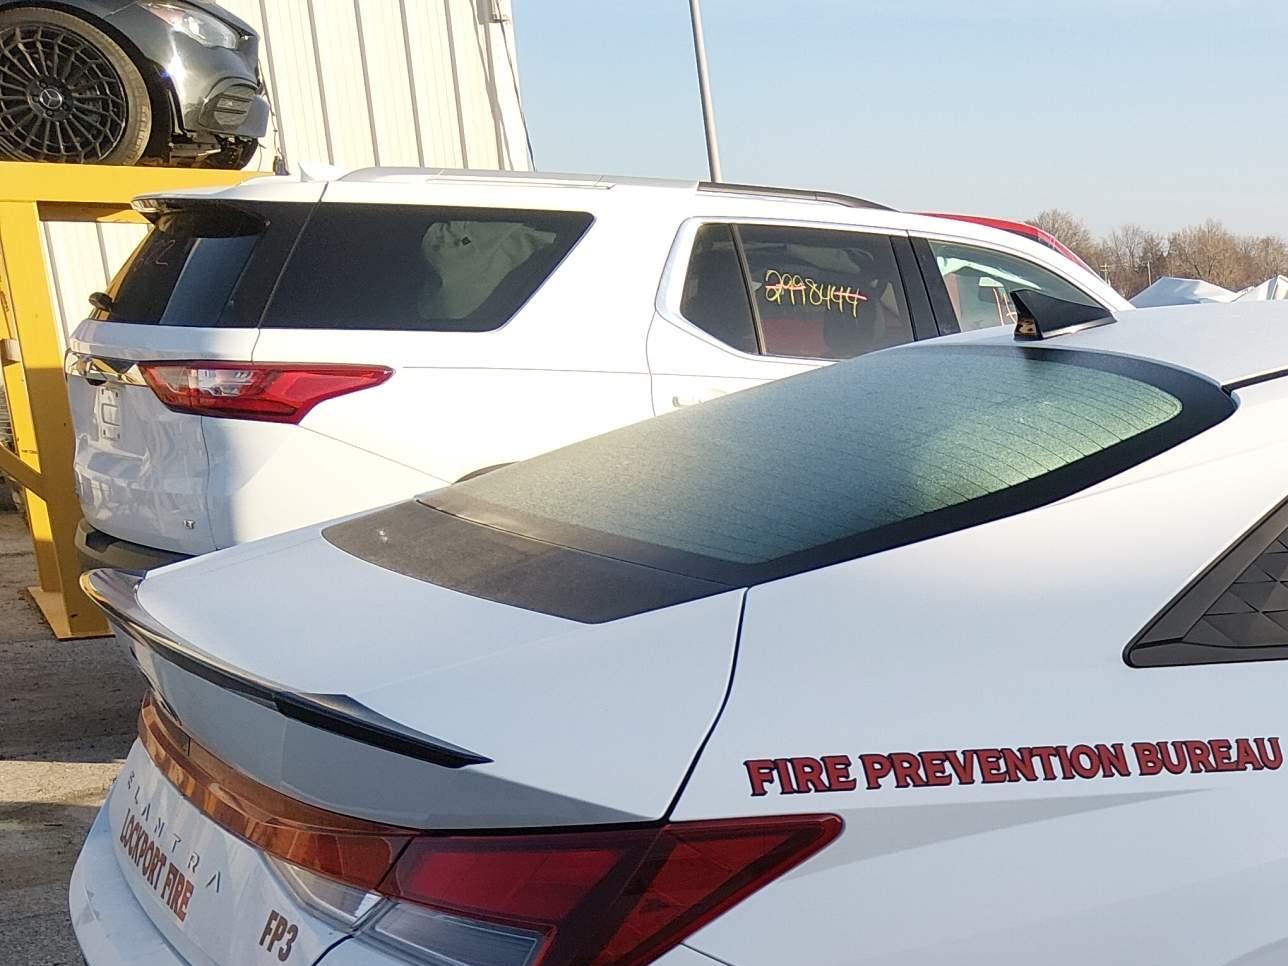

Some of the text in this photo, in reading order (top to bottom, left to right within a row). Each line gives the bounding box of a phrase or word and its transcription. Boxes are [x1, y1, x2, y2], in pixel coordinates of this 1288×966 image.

[743, 737, 1285, 796] FIRE PREVENTION BUREAU
[120, 807, 195, 922] LOCKPORT FIRE
[259, 909, 299, 962] FP3
